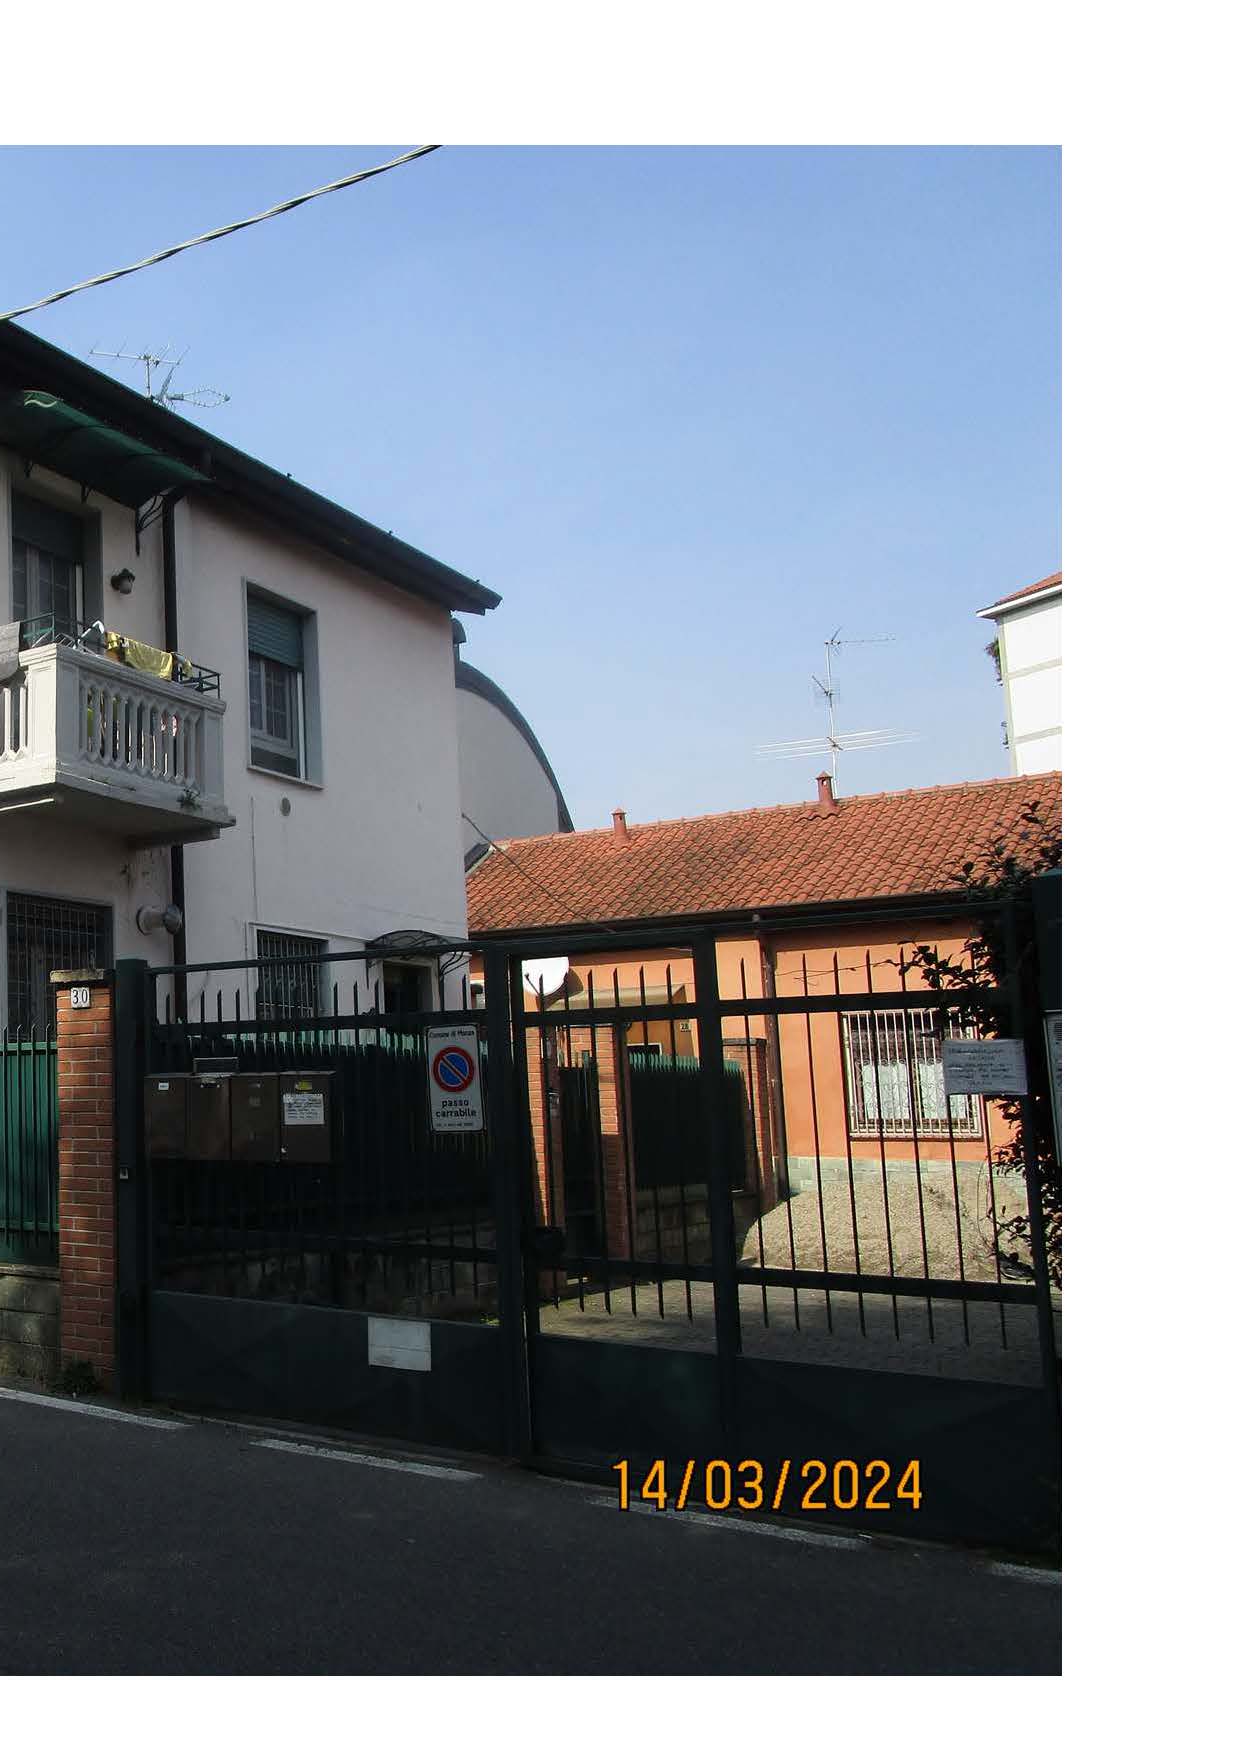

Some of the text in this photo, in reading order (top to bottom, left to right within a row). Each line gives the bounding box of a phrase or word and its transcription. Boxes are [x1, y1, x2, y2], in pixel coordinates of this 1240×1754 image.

[72, 988, 88, 1004] 30
[441, 1099, 470, 1108] passo
[435, 1108, 477, 1118] carrabile
